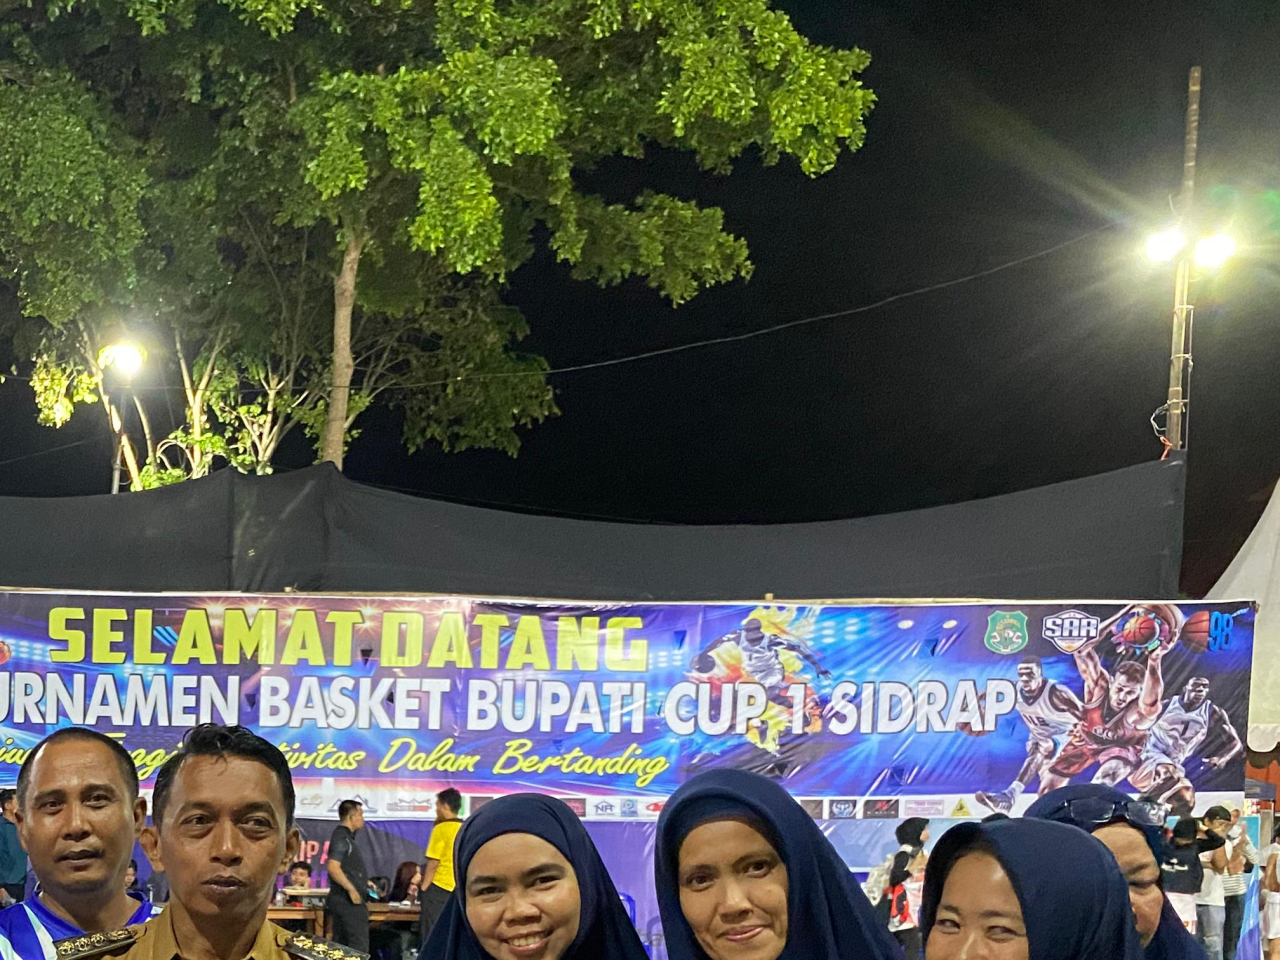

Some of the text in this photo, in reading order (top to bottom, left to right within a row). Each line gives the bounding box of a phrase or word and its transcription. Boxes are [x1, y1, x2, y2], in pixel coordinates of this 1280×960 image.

[47, 606, 650, 673] SELAMAT DATANG
[1044, 618, 1098, 637] SAR
[1207, 611, 1234, 652] 98
[258, 675, 452, 731] BASKET
[466, 678, 648, 734] BUPATI
[664, 681, 768, 736] CUP
[785, 681, 807, 735] 1
[827, 678, 1017, 737] SIDRAP
[378, 737, 481, 774] Dalam
[492, 738, 670, 789] Bertanding
